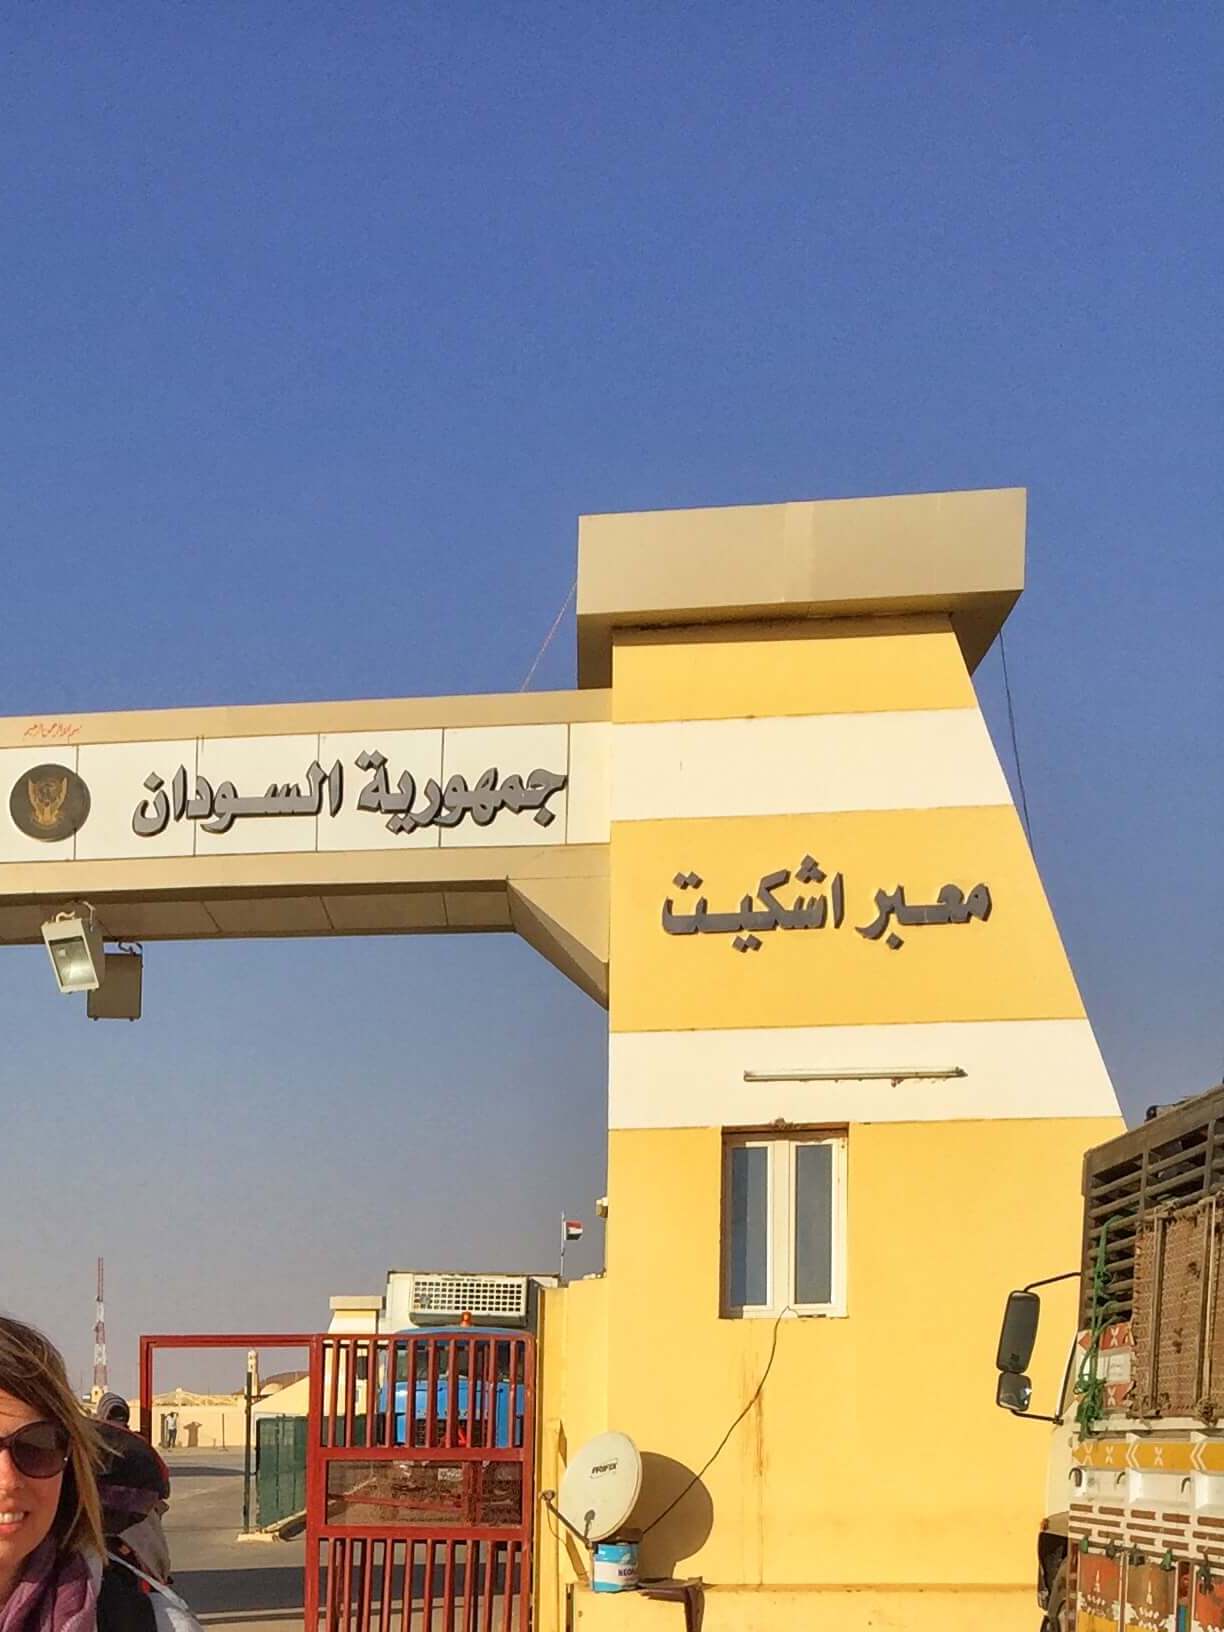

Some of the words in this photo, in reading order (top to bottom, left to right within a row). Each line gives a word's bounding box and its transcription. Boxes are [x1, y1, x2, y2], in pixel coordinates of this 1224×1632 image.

[132, 758, 343, 836] السودان
[357, 750, 568, 834] جمهورية
[662, 854, 844, 953] اشكيت
[855, 883, 992, 950] معبر
